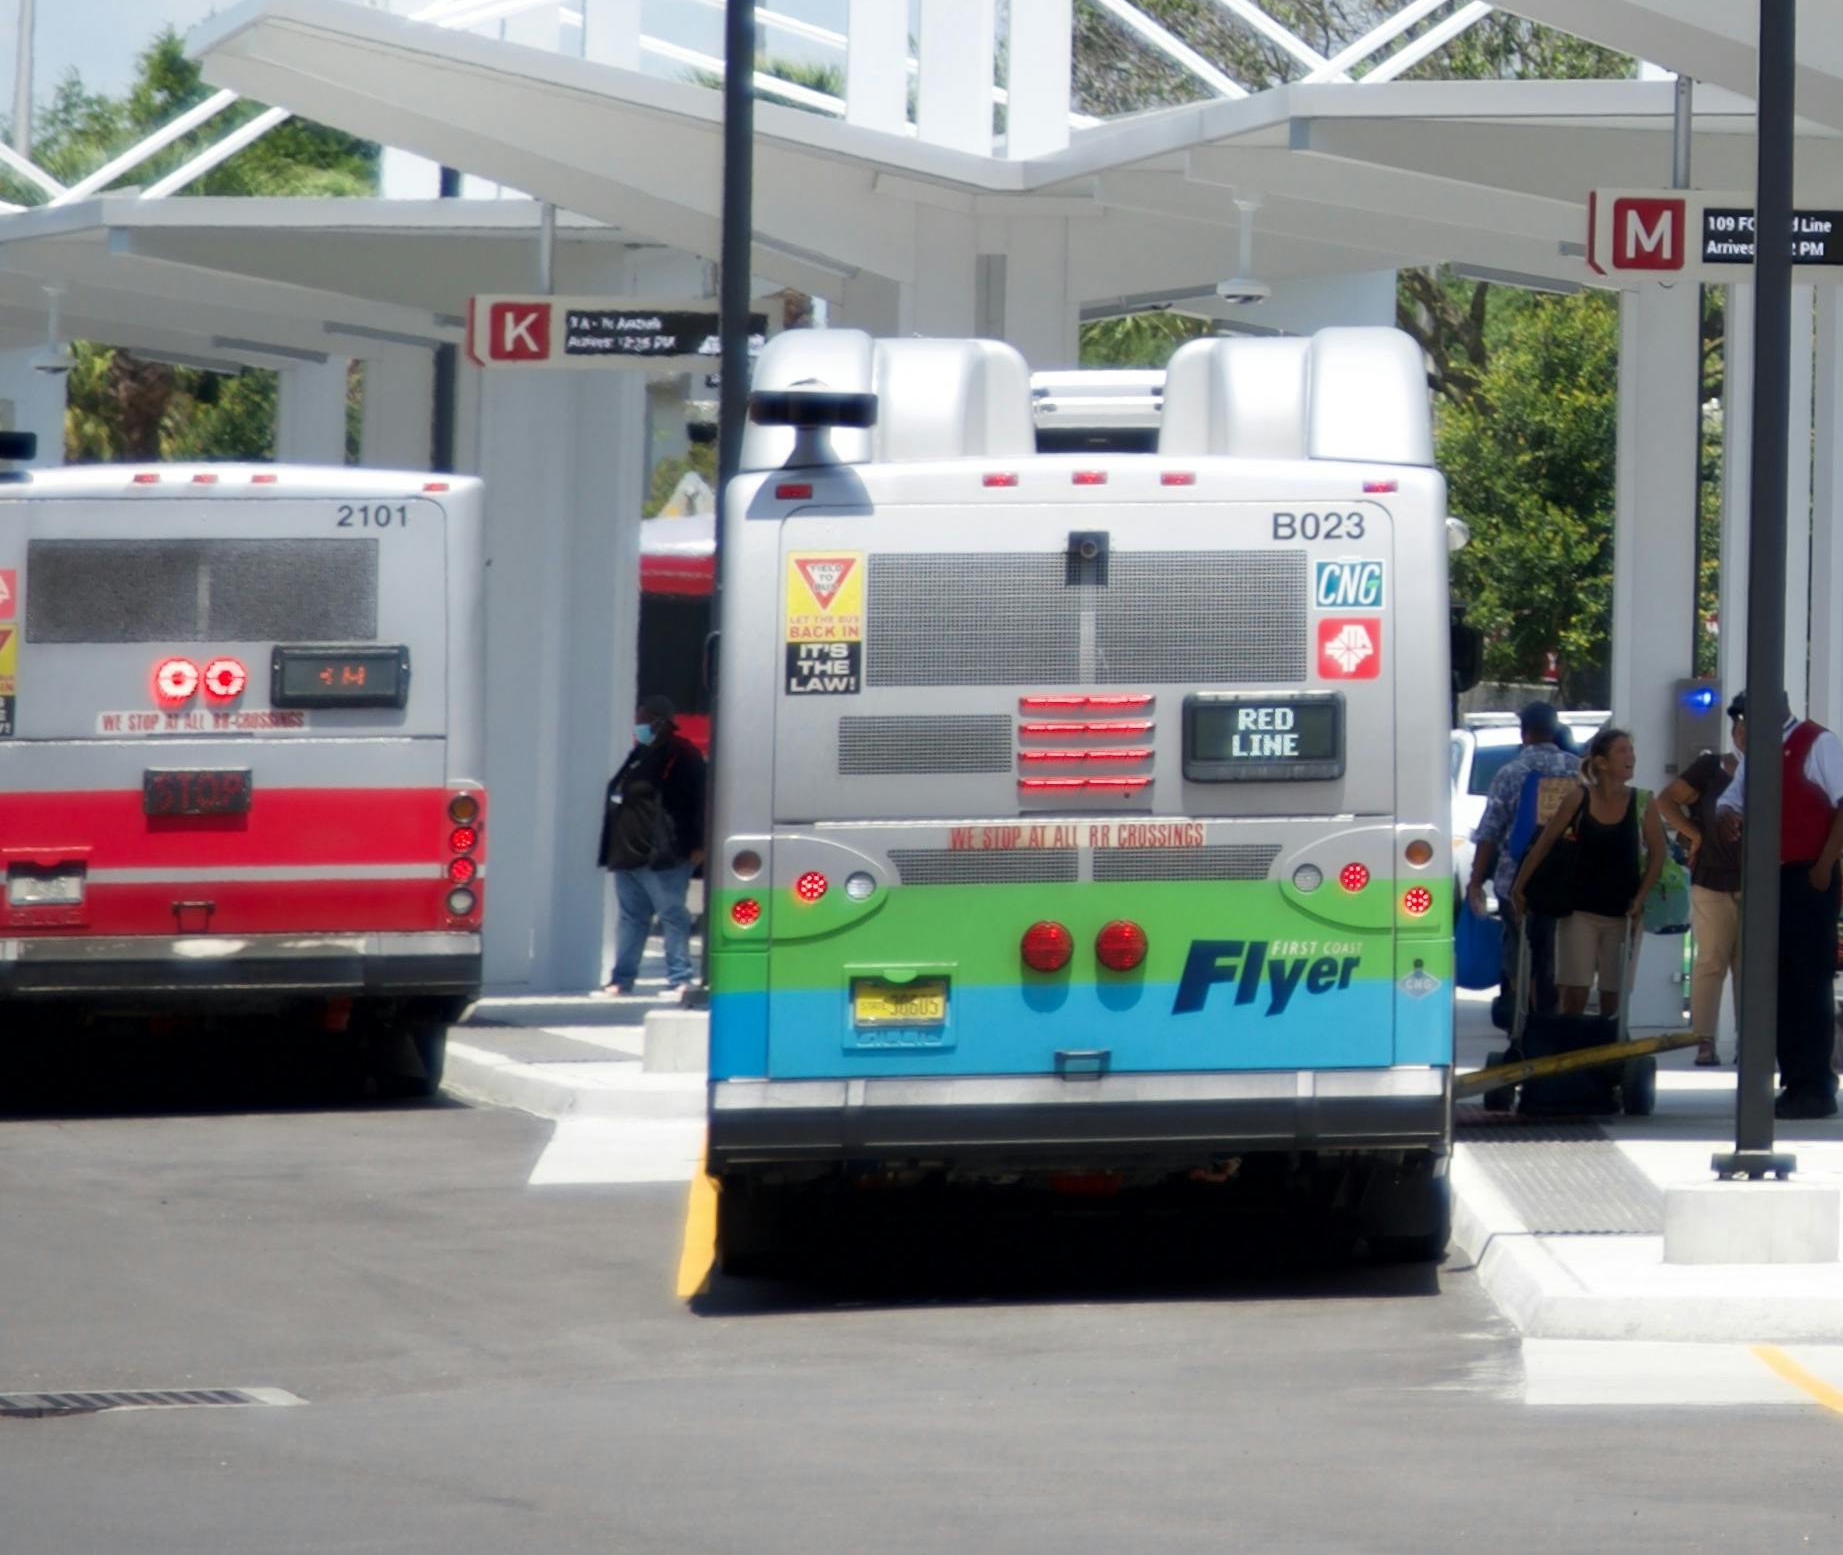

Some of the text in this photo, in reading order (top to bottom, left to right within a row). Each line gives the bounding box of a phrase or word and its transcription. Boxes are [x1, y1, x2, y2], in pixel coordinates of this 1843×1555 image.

[1707, 215, 1736, 232] 109
[1801, 216, 1833, 233] Line
[1626, 209, 1673, 259] M
[1705, 238, 1755, 255] Arrives
[1799, 241, 1825, 256] PM
[504, 311, 540, 353] K
[336, 504, 407, 528] 2101
[1272, 512, 1366, 541] B023
[810, 565, 843, 573] YIELD
[819, 574, 833, 582] TO
[815, 583, 837, 592] BUS
[1317, 563, 1381, 606] CNG
[790, 615, 859, 624] LET THE BUS
[789, 625, 859, 638] BACK IN
[800, 643, 849, 659] IT'S
[797, 660, 850, 675] THE
[789, 677, 856, 693] LAW!
[102, 715, 121, 731] WE
[127, 714, 159, 731] STOP
[183, 713, 205, 730] ALL
[1237, 707, 1294, 731] RED
[1231, 733, 1300, 757] LINE
[152, 770, 246, 812] STOP
[951, 823, 1204, 850] WE STOP AT ALL RR CROSSINGS
[1270, 940, 1364, 956] FIRST COAST
[1170, 939, 1362, 1017] Flyer
